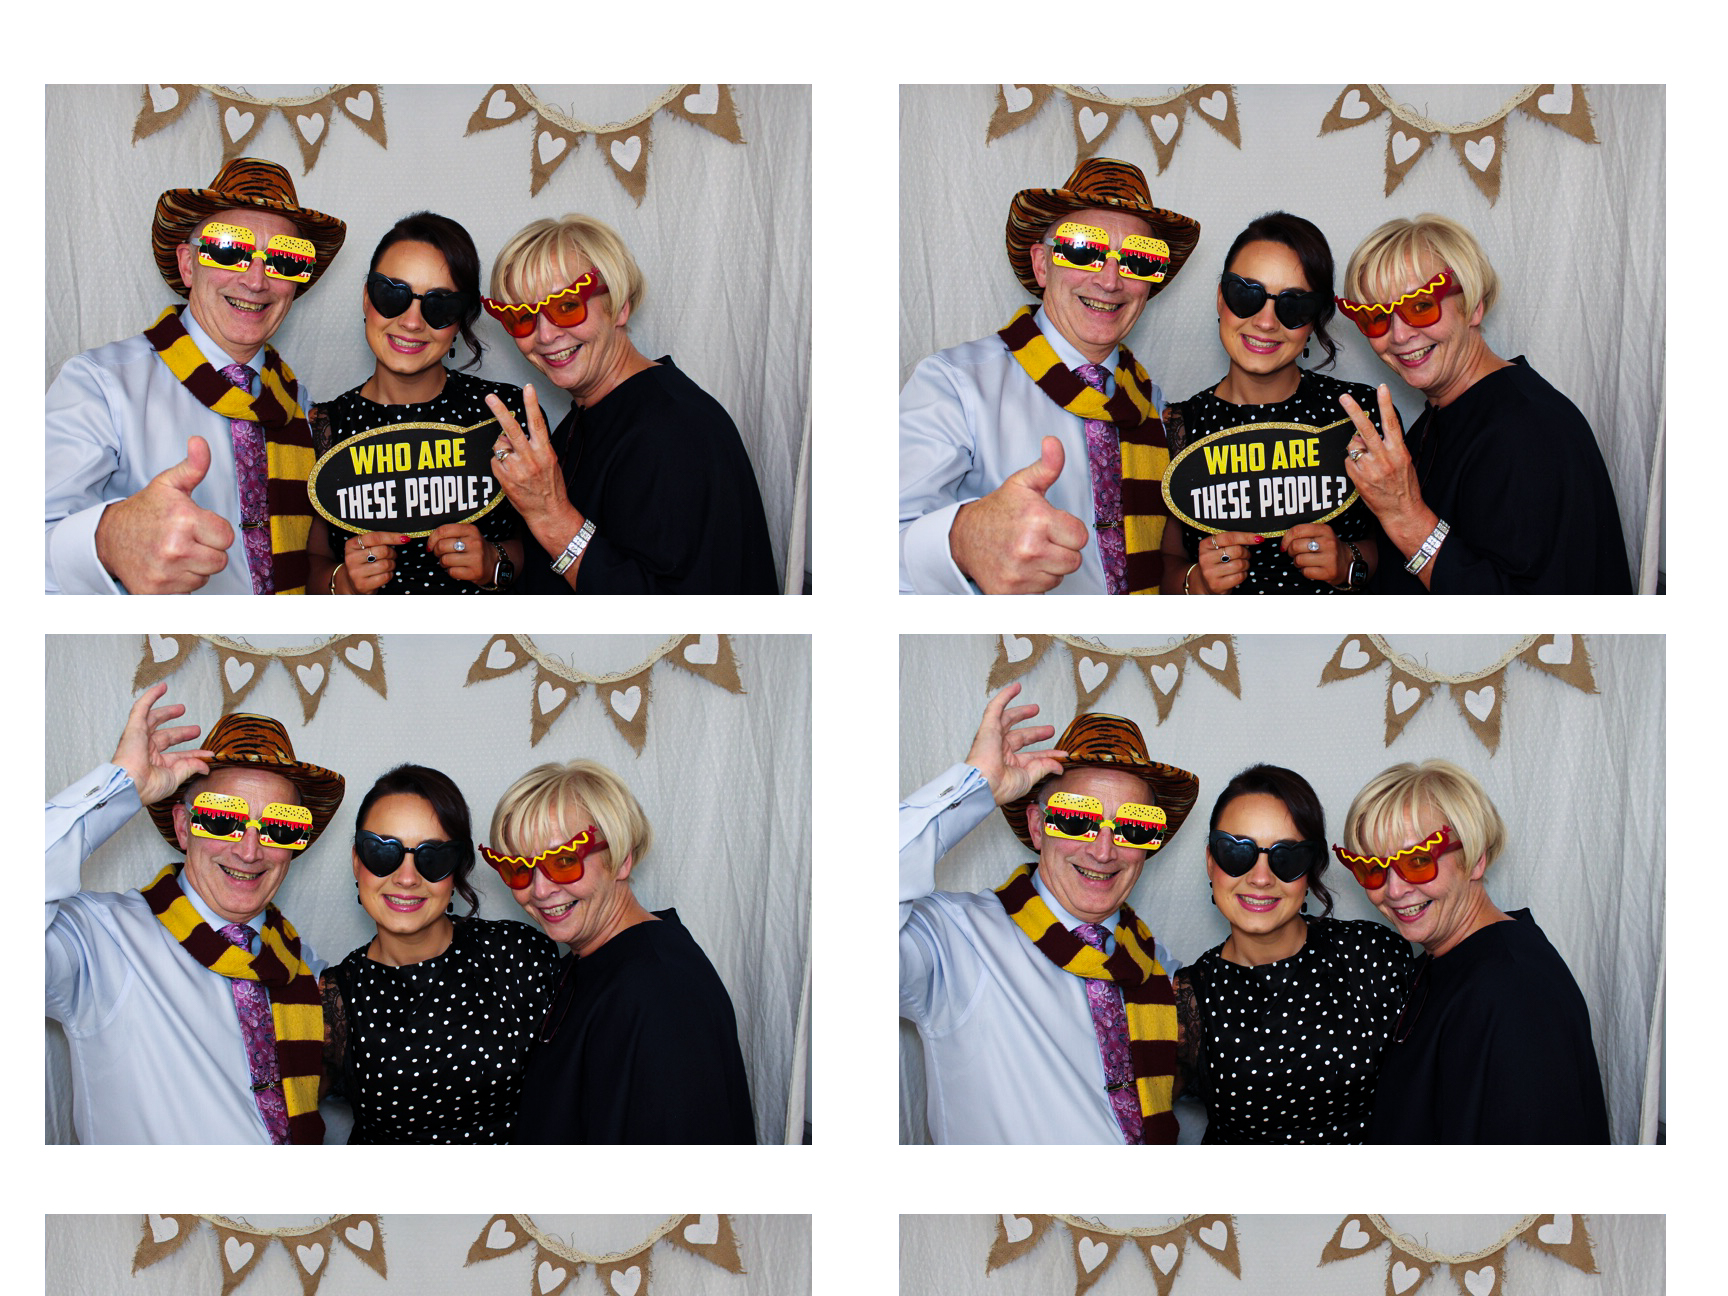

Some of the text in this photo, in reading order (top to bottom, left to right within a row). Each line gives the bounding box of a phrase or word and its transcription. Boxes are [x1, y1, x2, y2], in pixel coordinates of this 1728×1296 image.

[349, 437, 466, 475] WHO ARE
[1203, 437, 1320, 475] WHO ARE
[336, 480, 398, 520] THESE
[1190, 480, 1252, 520] THESE
